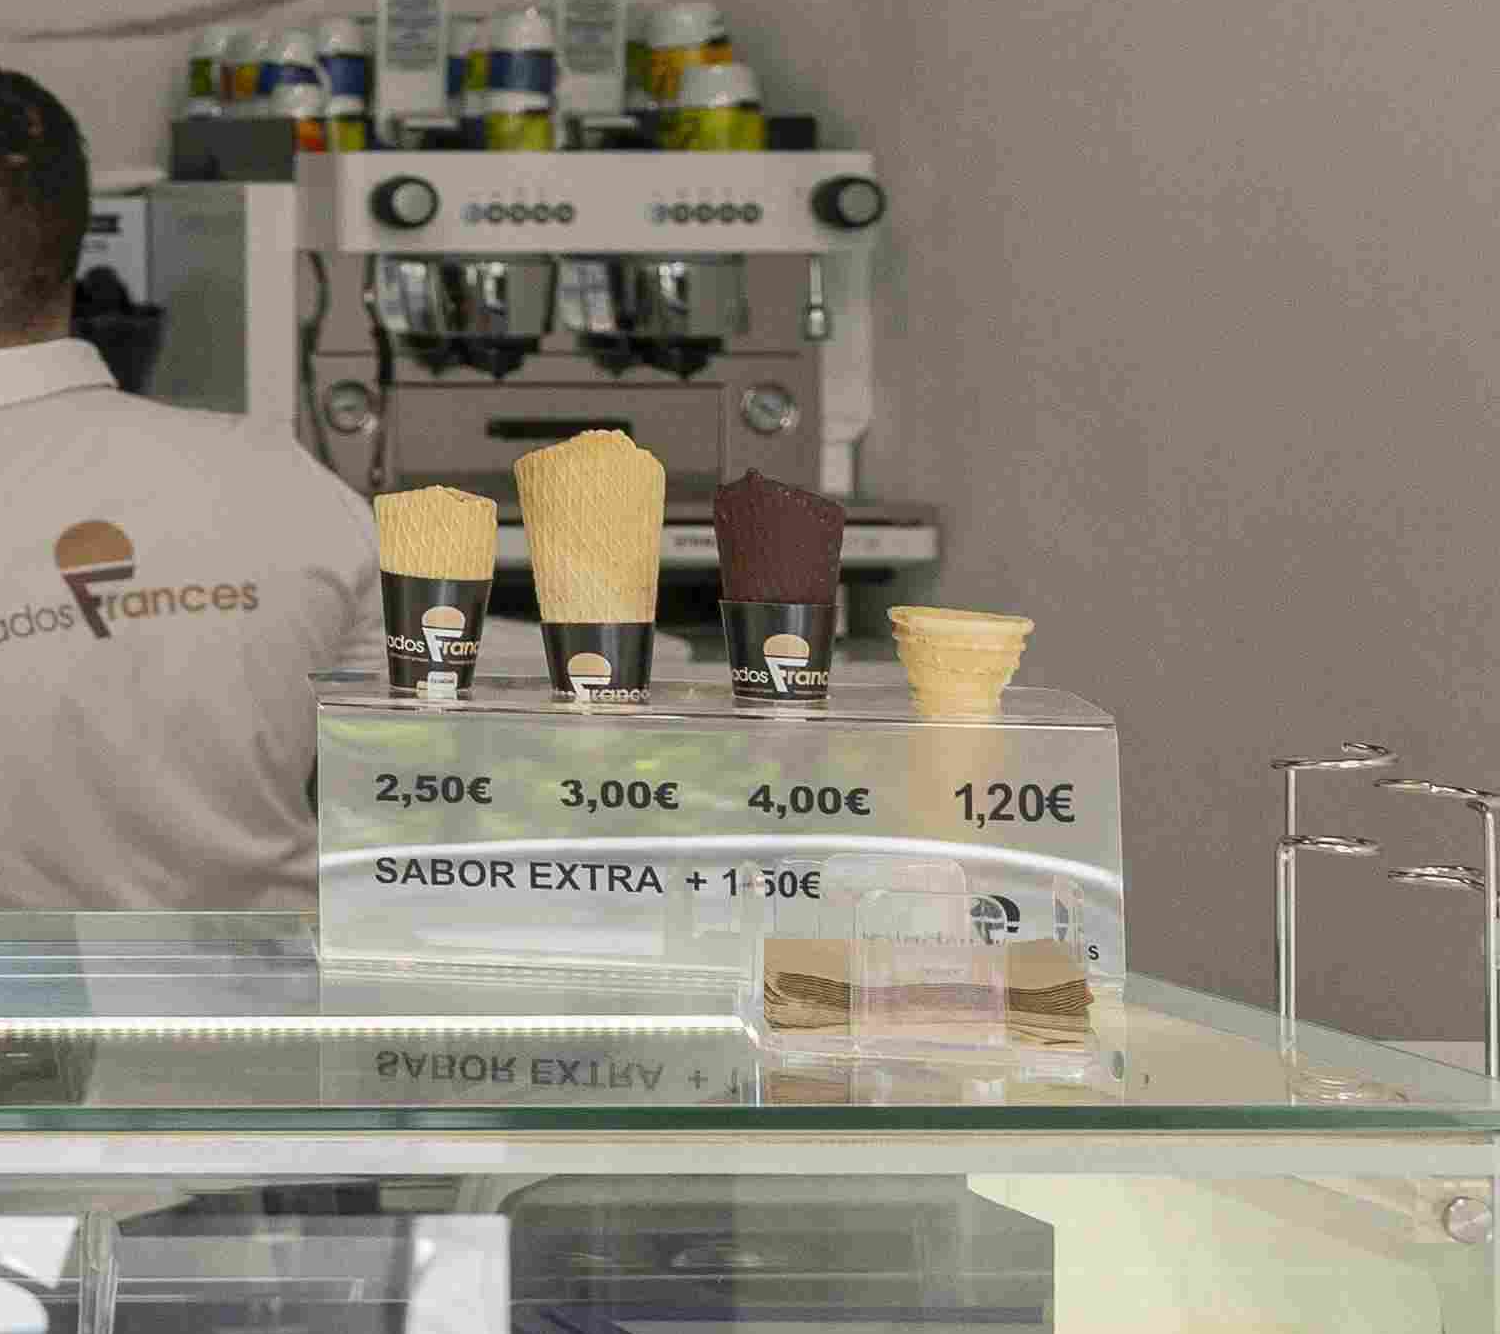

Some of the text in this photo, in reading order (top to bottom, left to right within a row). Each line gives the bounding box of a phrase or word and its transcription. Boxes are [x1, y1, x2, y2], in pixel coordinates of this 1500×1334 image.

[374, 772, 1077, 827] 2,50€ 3,00€ 4,00€ 1,20€
[374, 856, 822, 901] SABOR EXTRA + 150€
